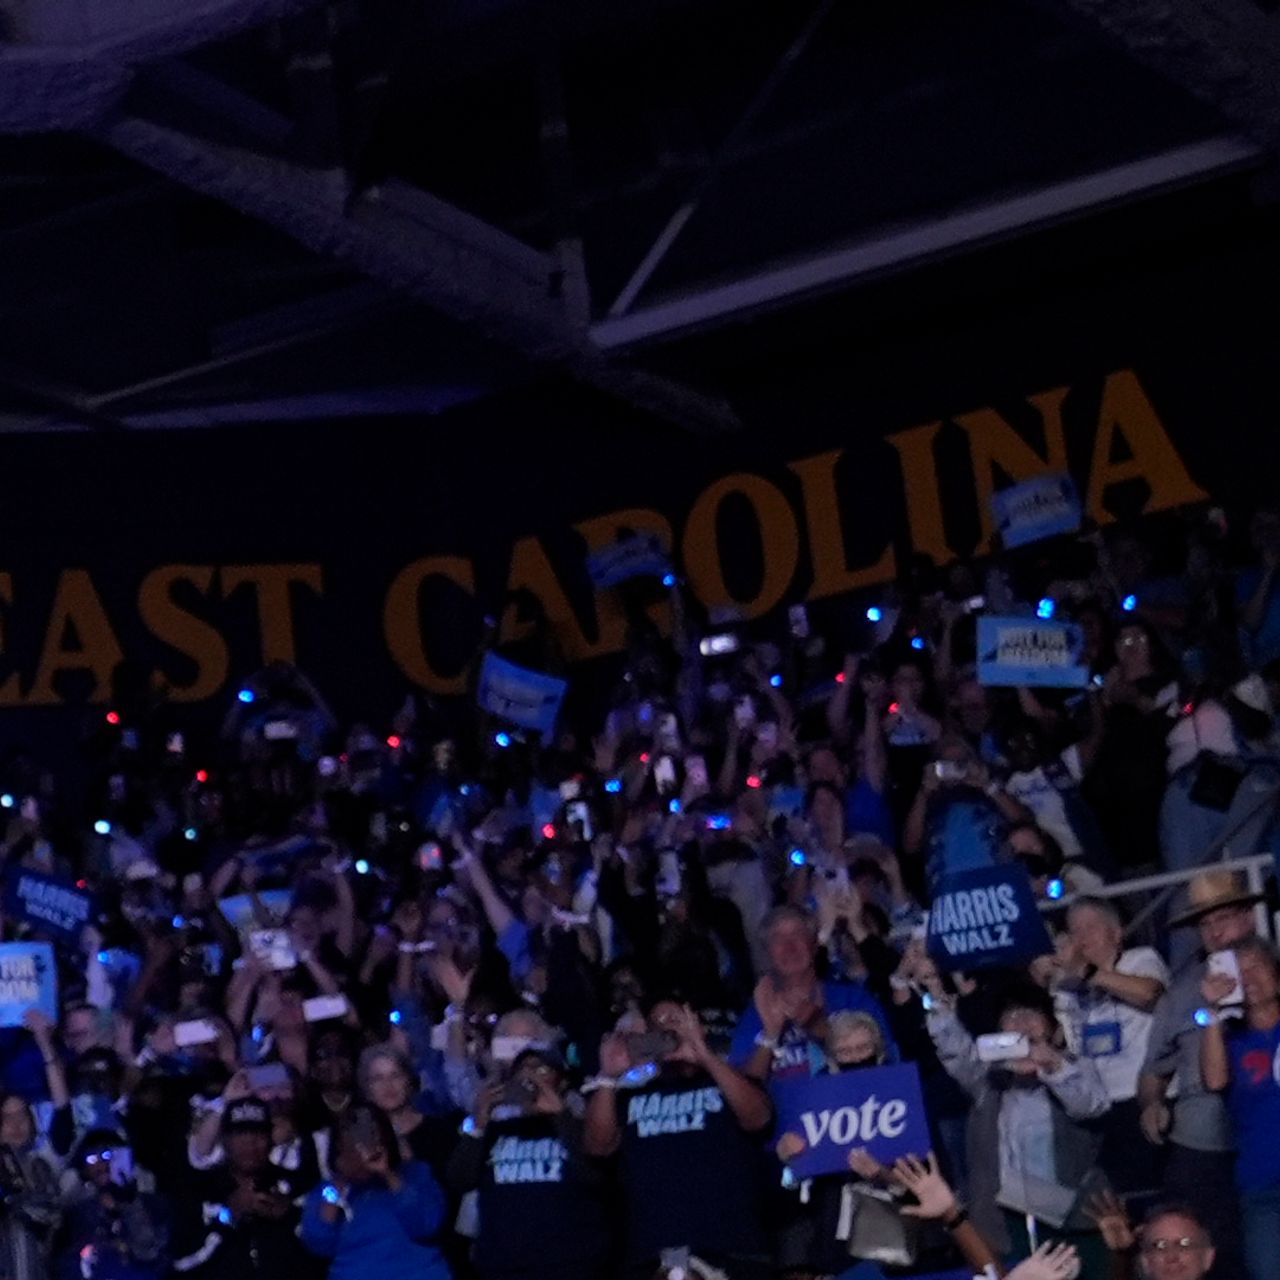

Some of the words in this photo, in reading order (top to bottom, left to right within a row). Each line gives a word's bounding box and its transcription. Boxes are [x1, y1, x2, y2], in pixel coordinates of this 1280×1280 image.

[929, 882, 1020, 935] HARRIS
[941, 922, 1015, 956] WALZ
[799, 1093, 909, 1148] vote
[493, 1157, 564, 1185] WALZ
